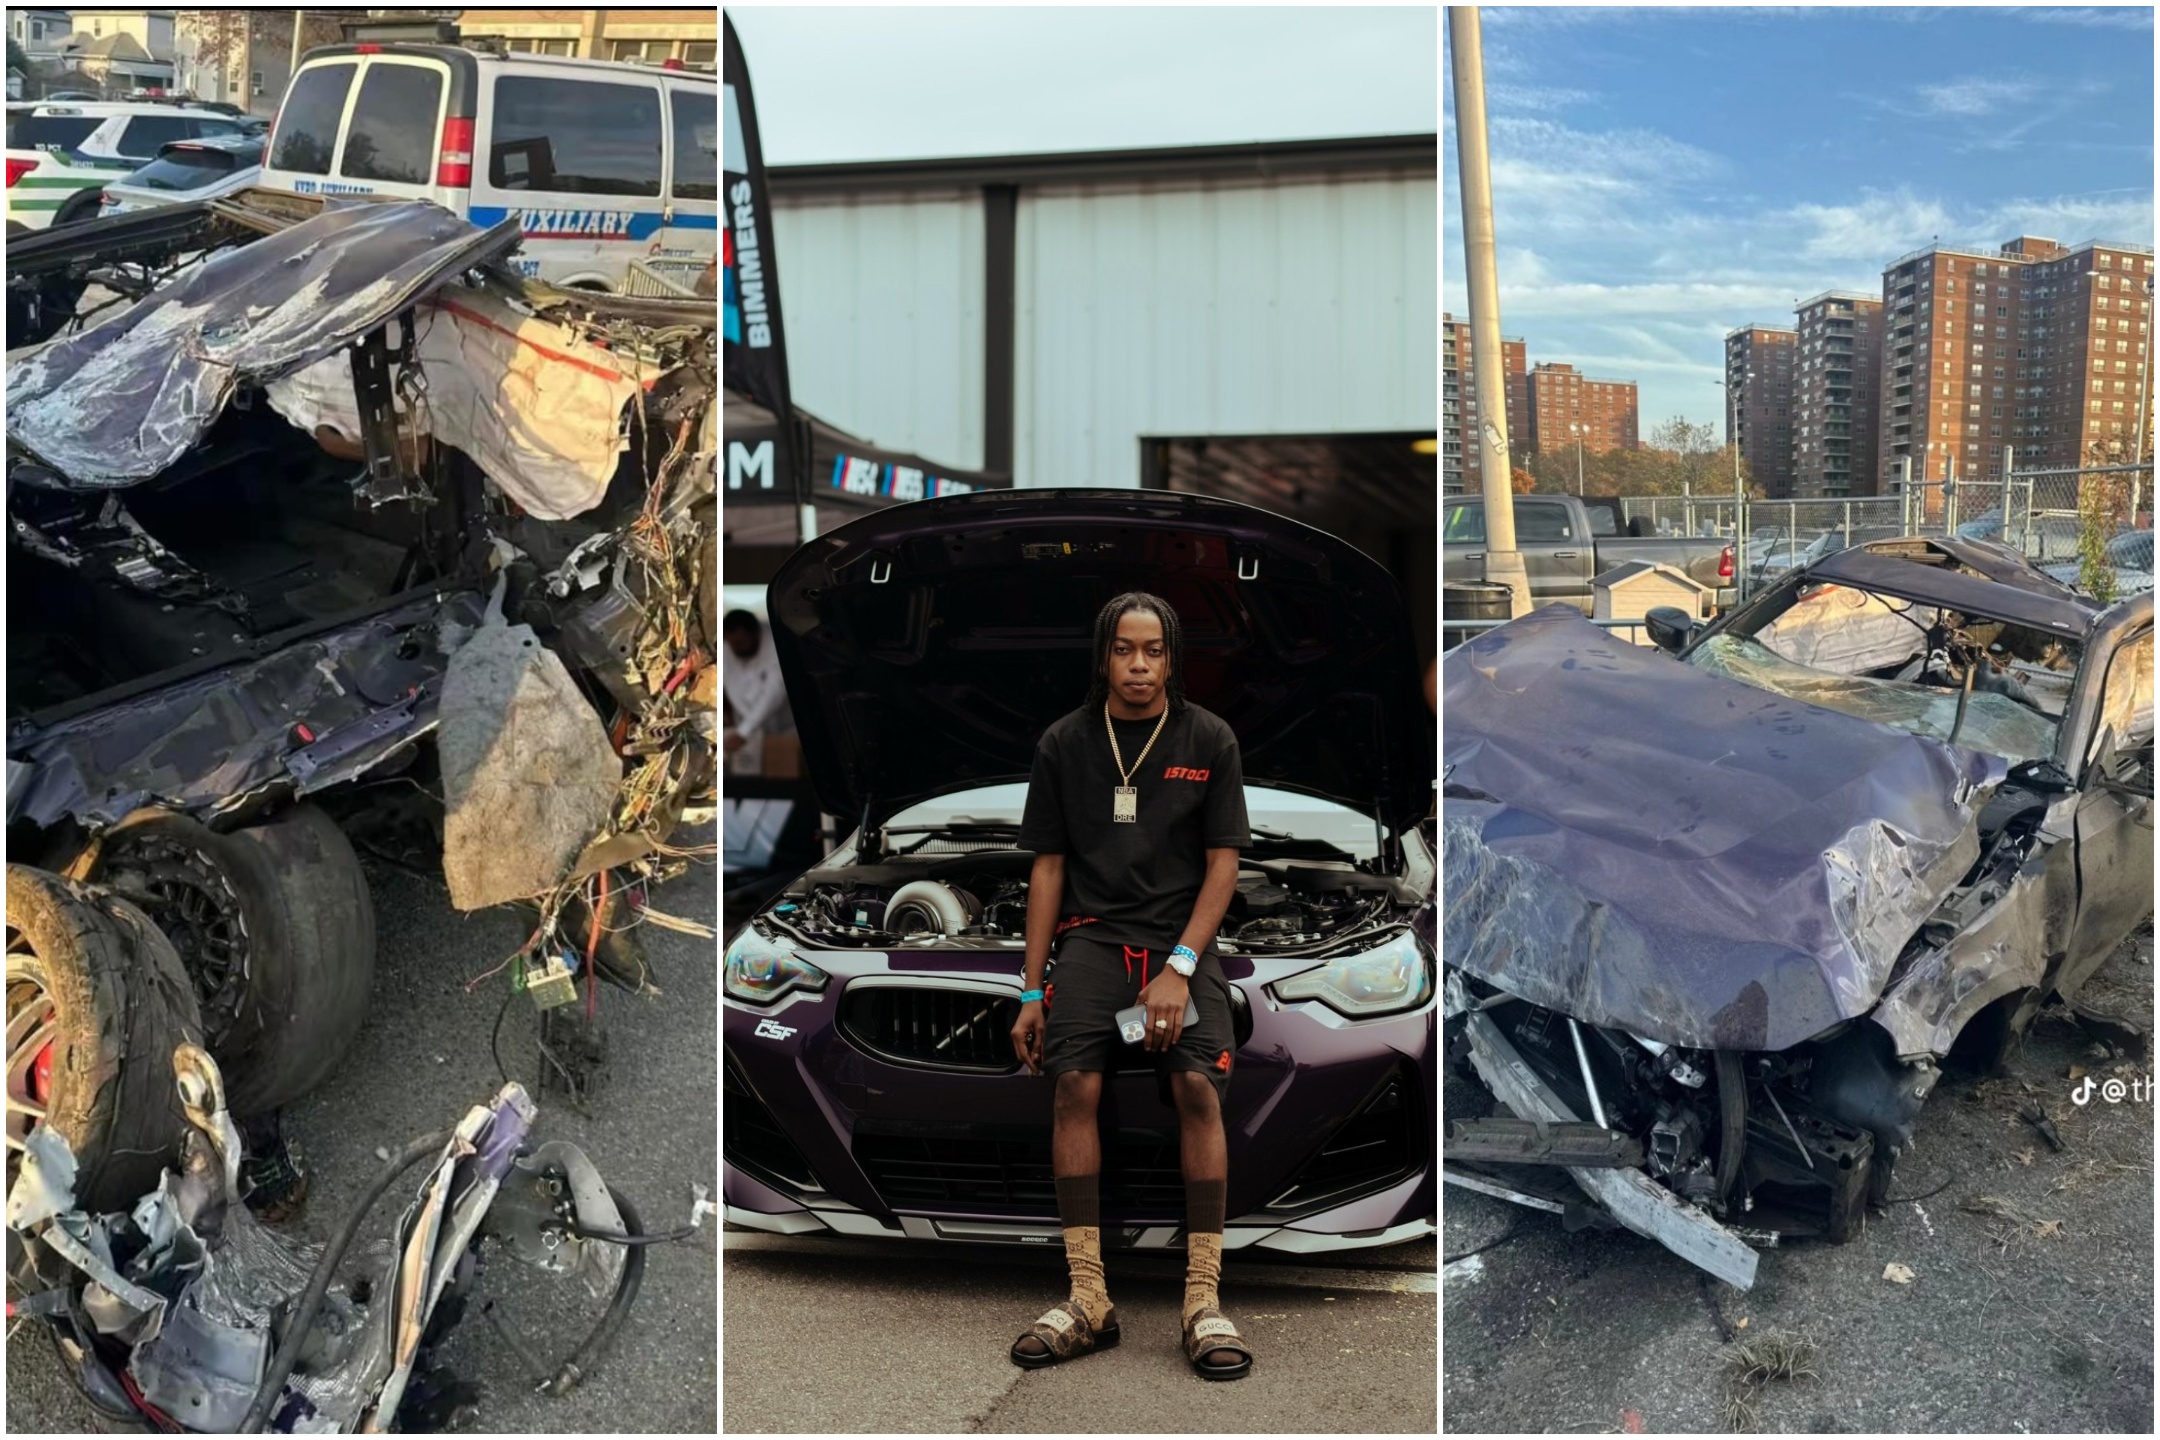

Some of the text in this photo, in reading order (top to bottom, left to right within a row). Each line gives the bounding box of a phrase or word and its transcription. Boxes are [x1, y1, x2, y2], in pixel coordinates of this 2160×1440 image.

[731, 180, 772, 348] BIMMERS
[754, 1022, 798, 1041] CSF
[1198, 1322, 1233, 1332] GUCCI
